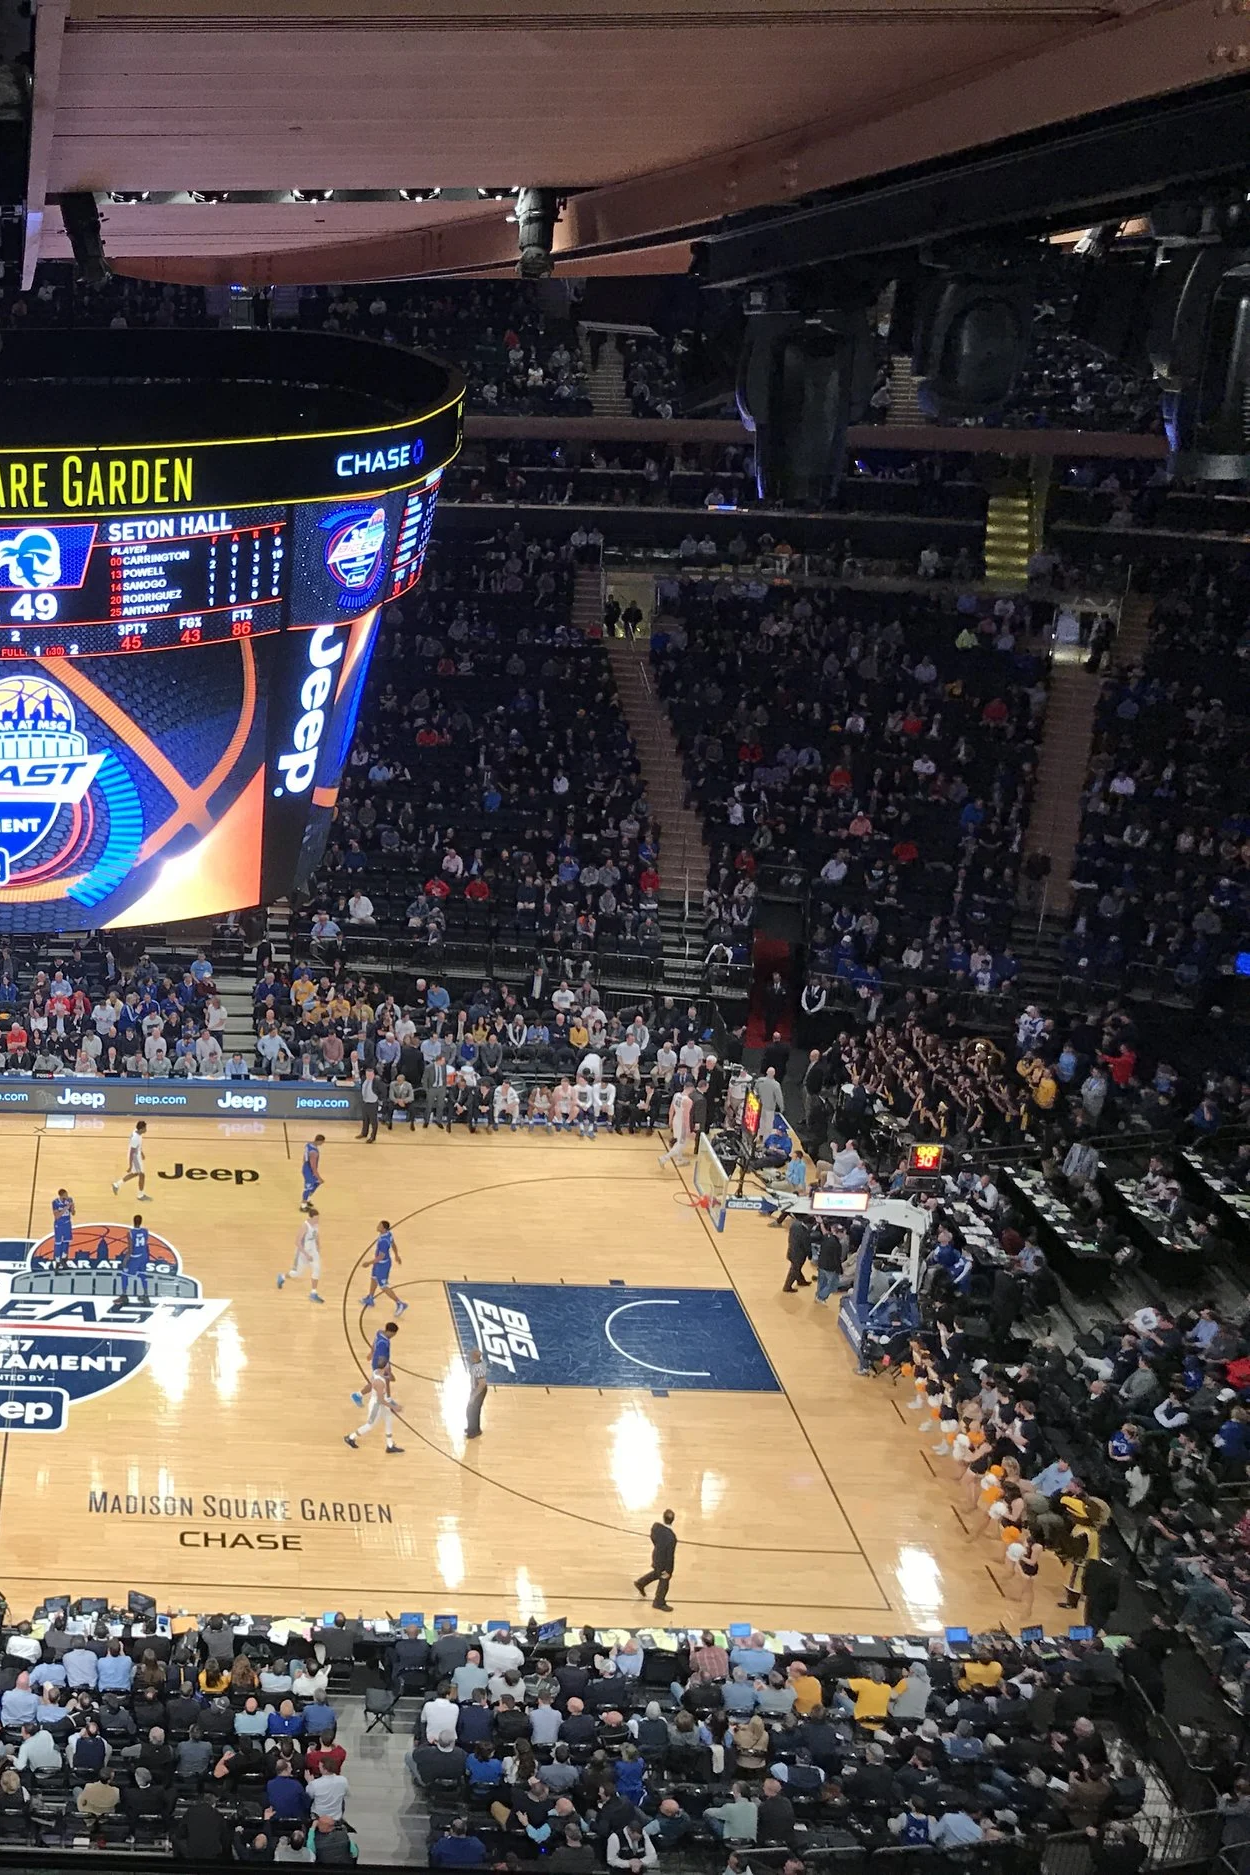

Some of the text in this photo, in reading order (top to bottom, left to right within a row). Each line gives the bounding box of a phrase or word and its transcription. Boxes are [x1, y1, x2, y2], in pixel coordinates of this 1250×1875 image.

[337, 445, 410, 476] CHASE
[62, 455, 193, 508] GARDEN
[108, 513, 232, 541] SETON HALL
[110, 558, 122, 566] 00
[123, 551, 189, 565] CARRINGTON
[210, 547, 215, 556] 1
[254, 541, 259, 550] 1
[111, 527, 280, 555] PLAYER F A R P
[111, 550, 283, 579] 13 POWELL 2 1 3 10
[111, 563, 280, 592] 14 SANOGO 1 1 3 2
[110, 575, 278, 604] 20 RODRIGUEZ 1 1 7
[11, 593, 58, 620] 49
[110, 598, 214, 616] 25 ANTHONY 1
[118, 609, 252, 635] 3PT% FG% FT%
[121, 622, 251, 649] 45 43 86
[11, 631, 20, 642] 2
[34, 647, 41, 656] 1
[70, 645, 79, 654] 2
[277, 625, 343, 793] Jeep
[17, 720, 35, 730] AT
[38, 721, 67, 731] MSG
[57, 1088, 105, 1108] Jeep
[134, 1093, 186, 1105] jeep.com
[218, 1091, 266, 1111] Jeep
[296, 1097, 348, 1109] jeep.com
[157, 1164, 259, 1185] Jeep
[917, 1156, 933, 1167] 30
[727, 1201, 762, 1209] GEICO
[97, 1260, 122, 1269] AT
[472, 1298, 516, 1374] EAST
[498, 1306, 540, 1361] BIG
[88, 1491, 393, 1524] MADISON SQUARE GARDEN
[179, 1531, 303, 1551] CHASE
